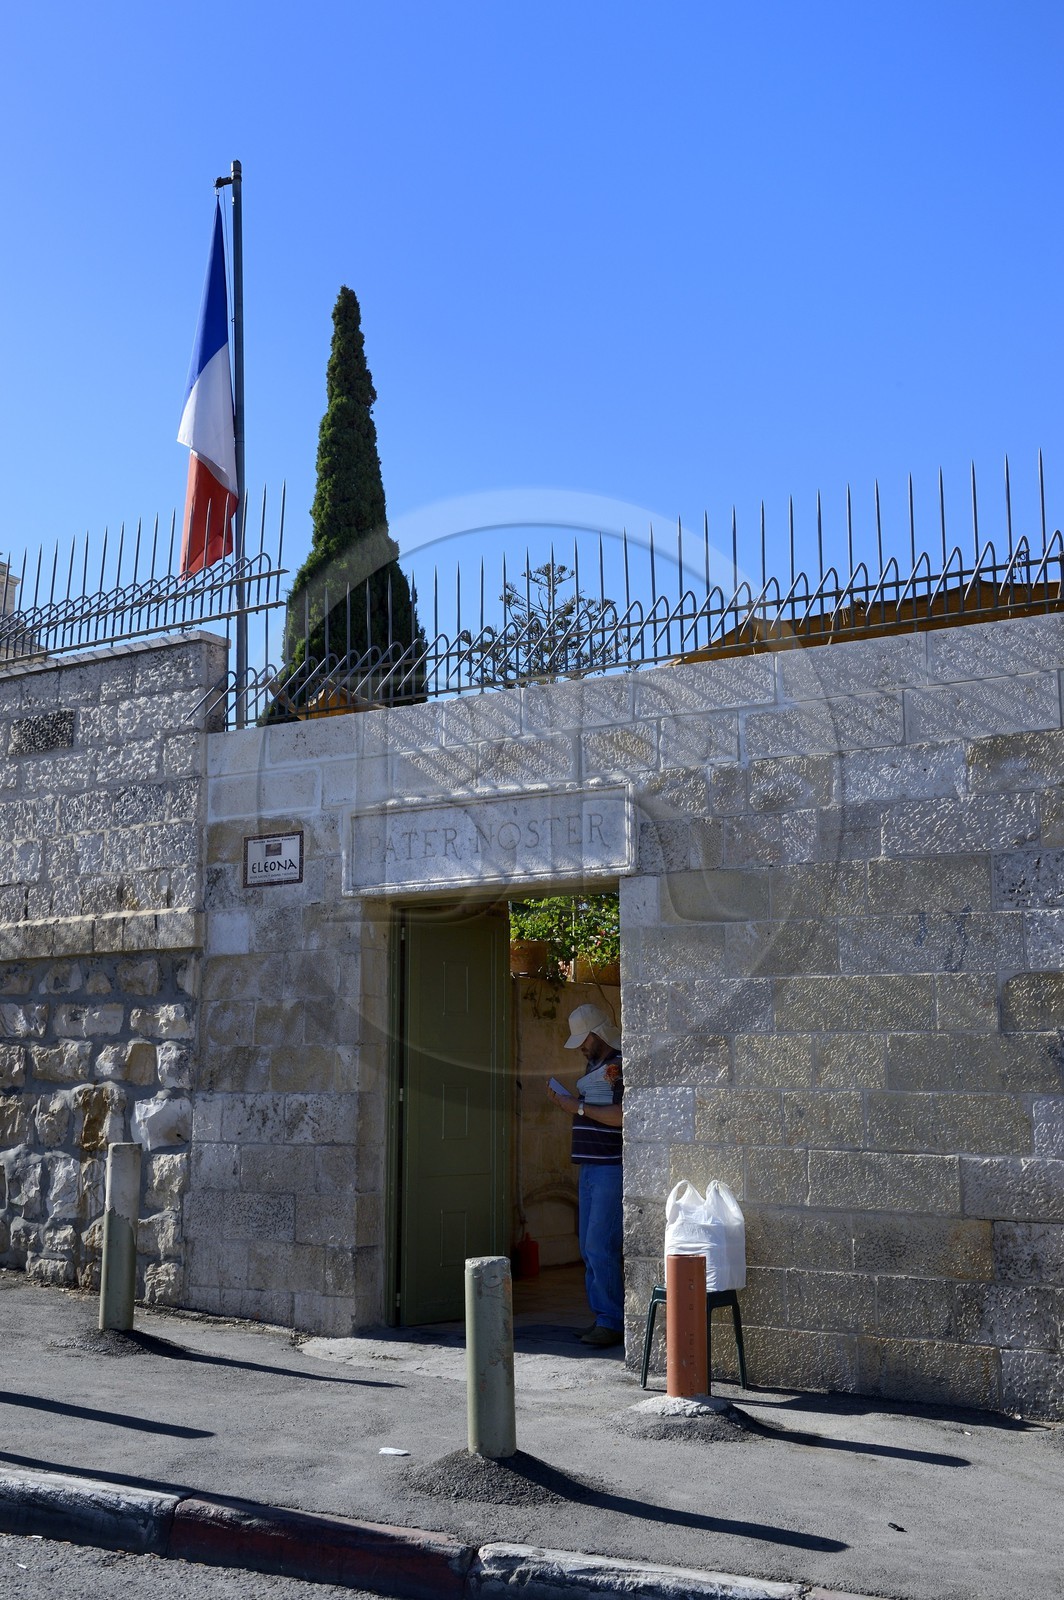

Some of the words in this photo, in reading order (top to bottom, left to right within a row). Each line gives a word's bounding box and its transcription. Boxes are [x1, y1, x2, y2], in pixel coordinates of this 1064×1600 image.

[367, 827, 463, 864] PATER
[473, 812, 612, 854] NOSTER
[251, 858, 298, 874] ELEONA
